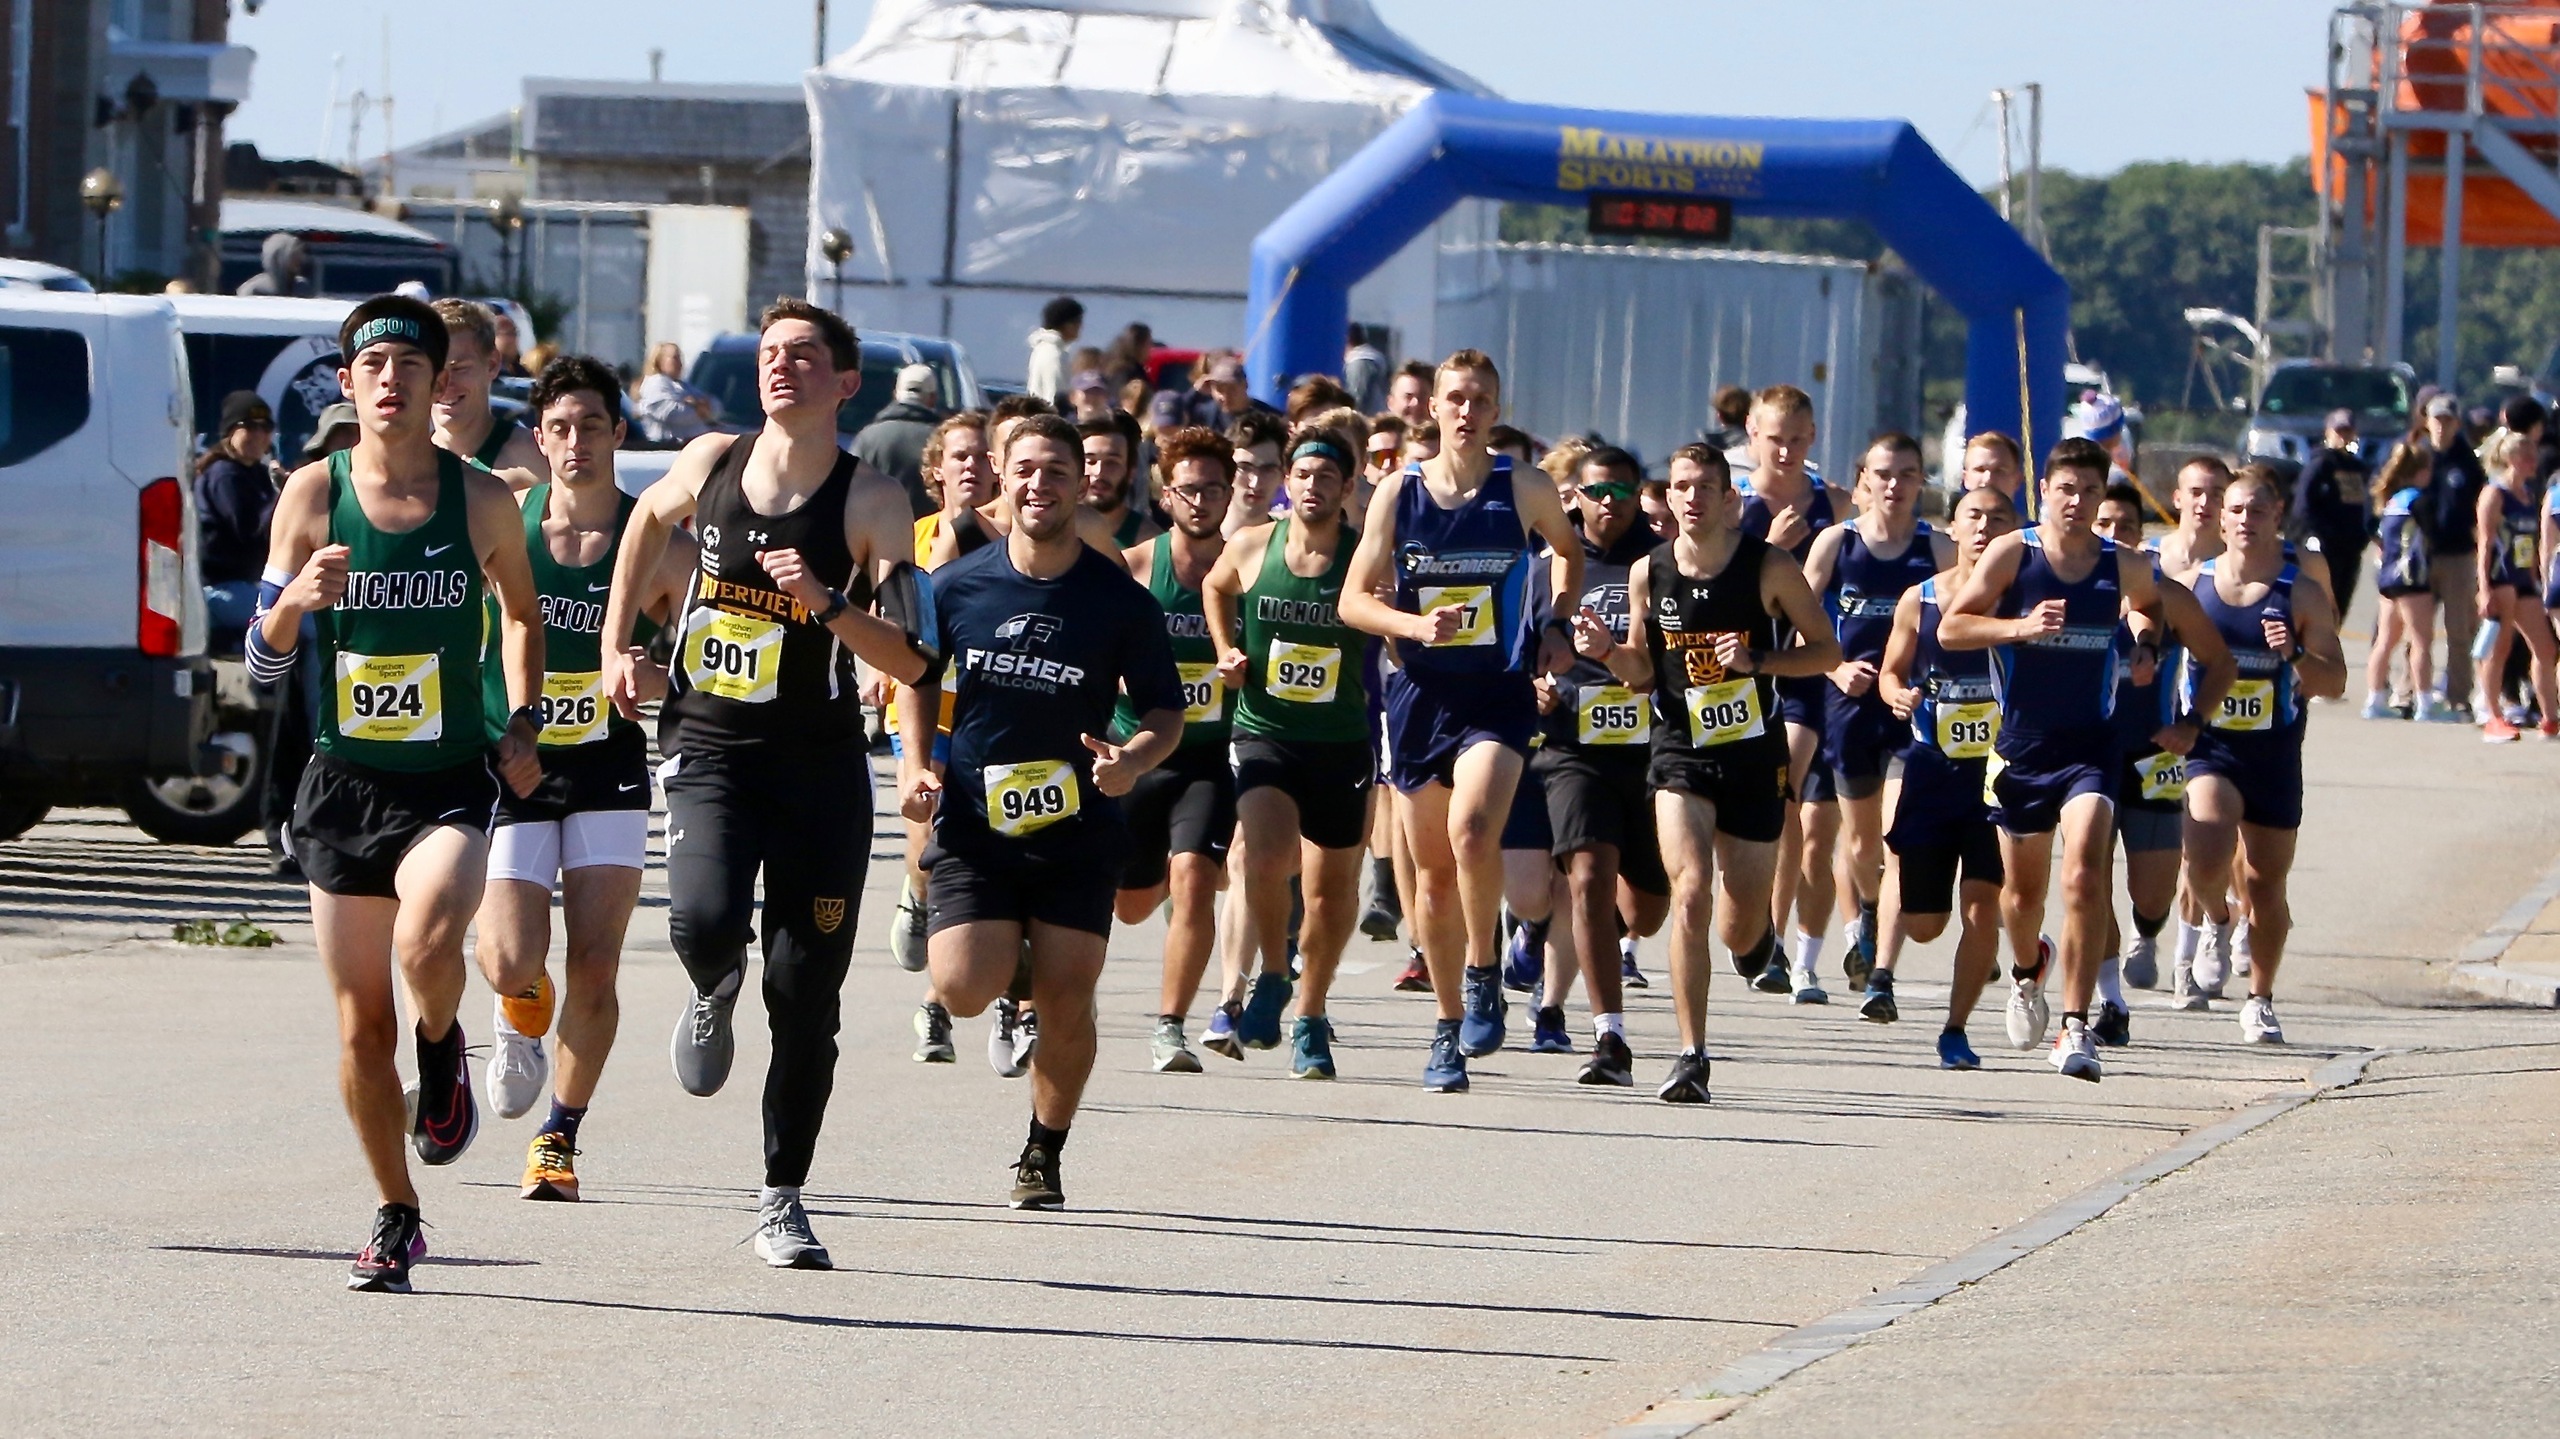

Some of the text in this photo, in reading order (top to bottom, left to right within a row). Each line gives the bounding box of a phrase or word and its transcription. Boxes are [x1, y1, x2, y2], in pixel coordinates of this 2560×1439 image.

[1560, 126, 1764, 170] MARATHON
[1558, 161, 1696, 191] SPORTS
[702, 637, 759, 681] 901
[965, 648, 1085, 686] FISHER
[980, 672, 1057, 695] FALCONS
[1278, 661, 1326, 690] 929
[352, 683, 423, 718] 924
[1182, 681, 1212, 706] 30
[2223, 696, 2262, 718] 916
[543, 696, 596, 726] 926
[1591, 705, 1638, 729] 955
[1700, 700, 1750, 731] 903
[1951, 721, 1990, 743] 913
[1003, 784, 1065, 820] 949
